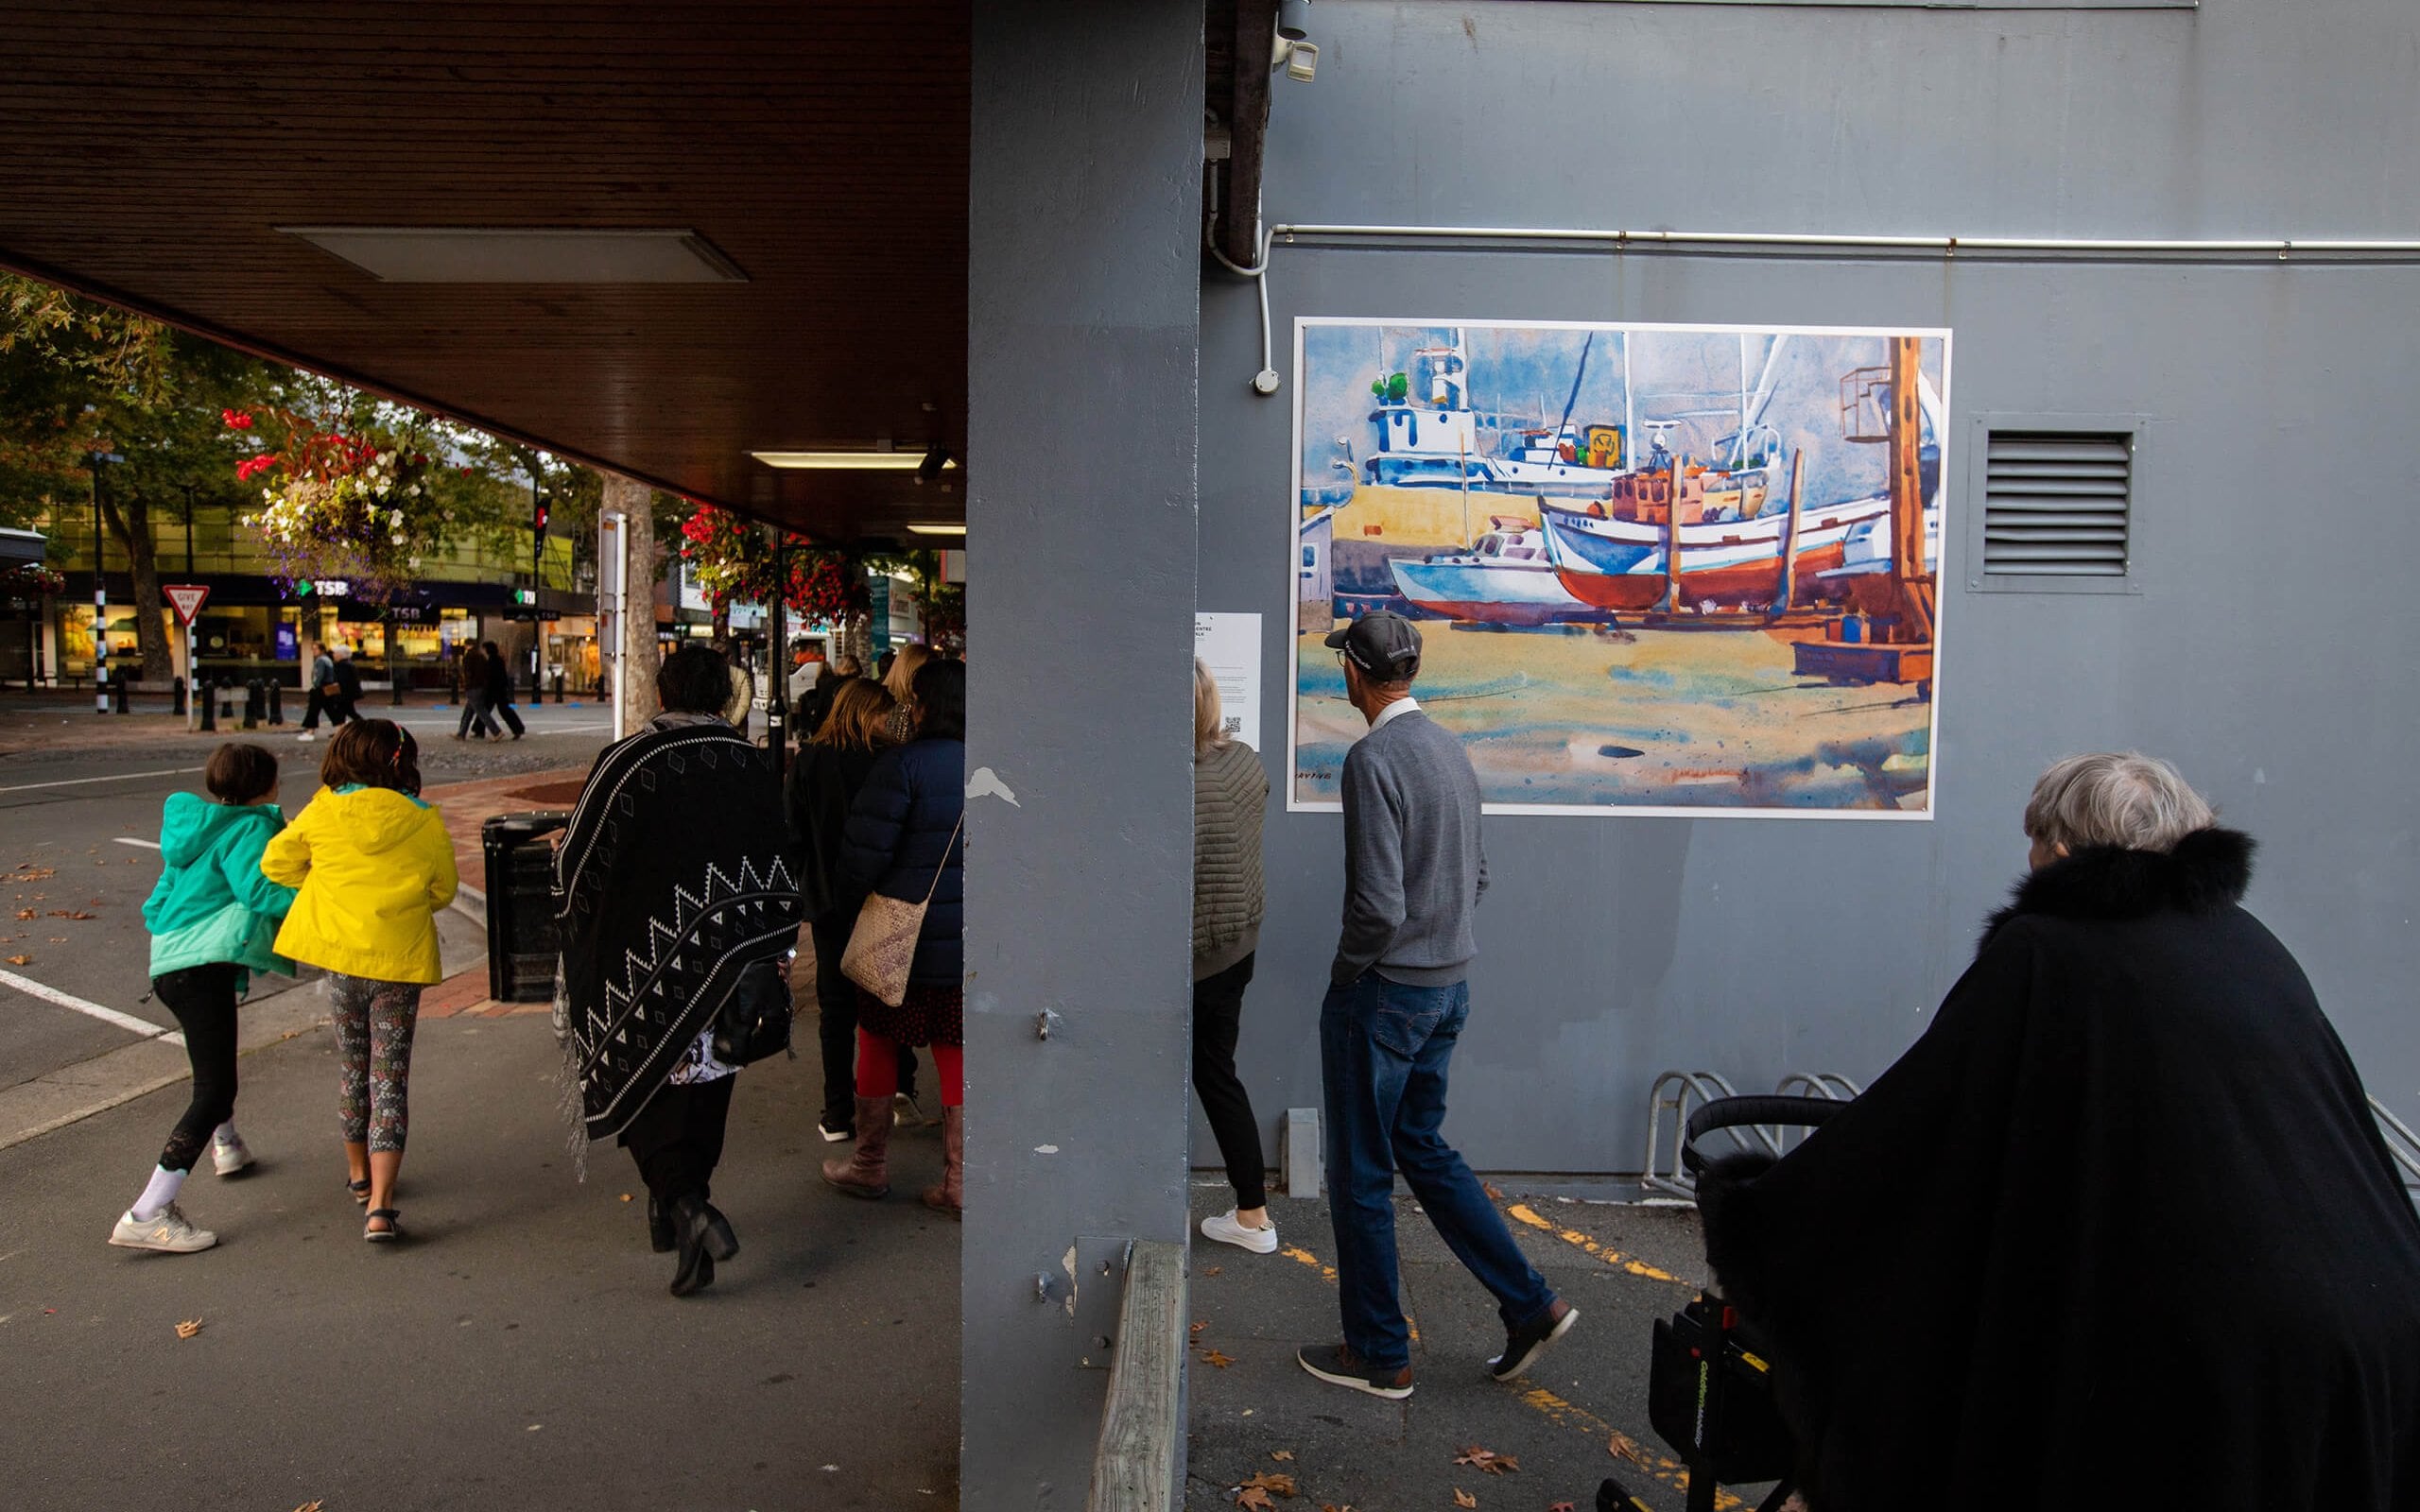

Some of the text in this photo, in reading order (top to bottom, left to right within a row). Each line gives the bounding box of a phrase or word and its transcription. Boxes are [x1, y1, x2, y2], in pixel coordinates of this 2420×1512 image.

[314, 580, 349, 596] TSB
[178, 593, 196, 602] GIVE
[391, 607, 421, 620] TSB
